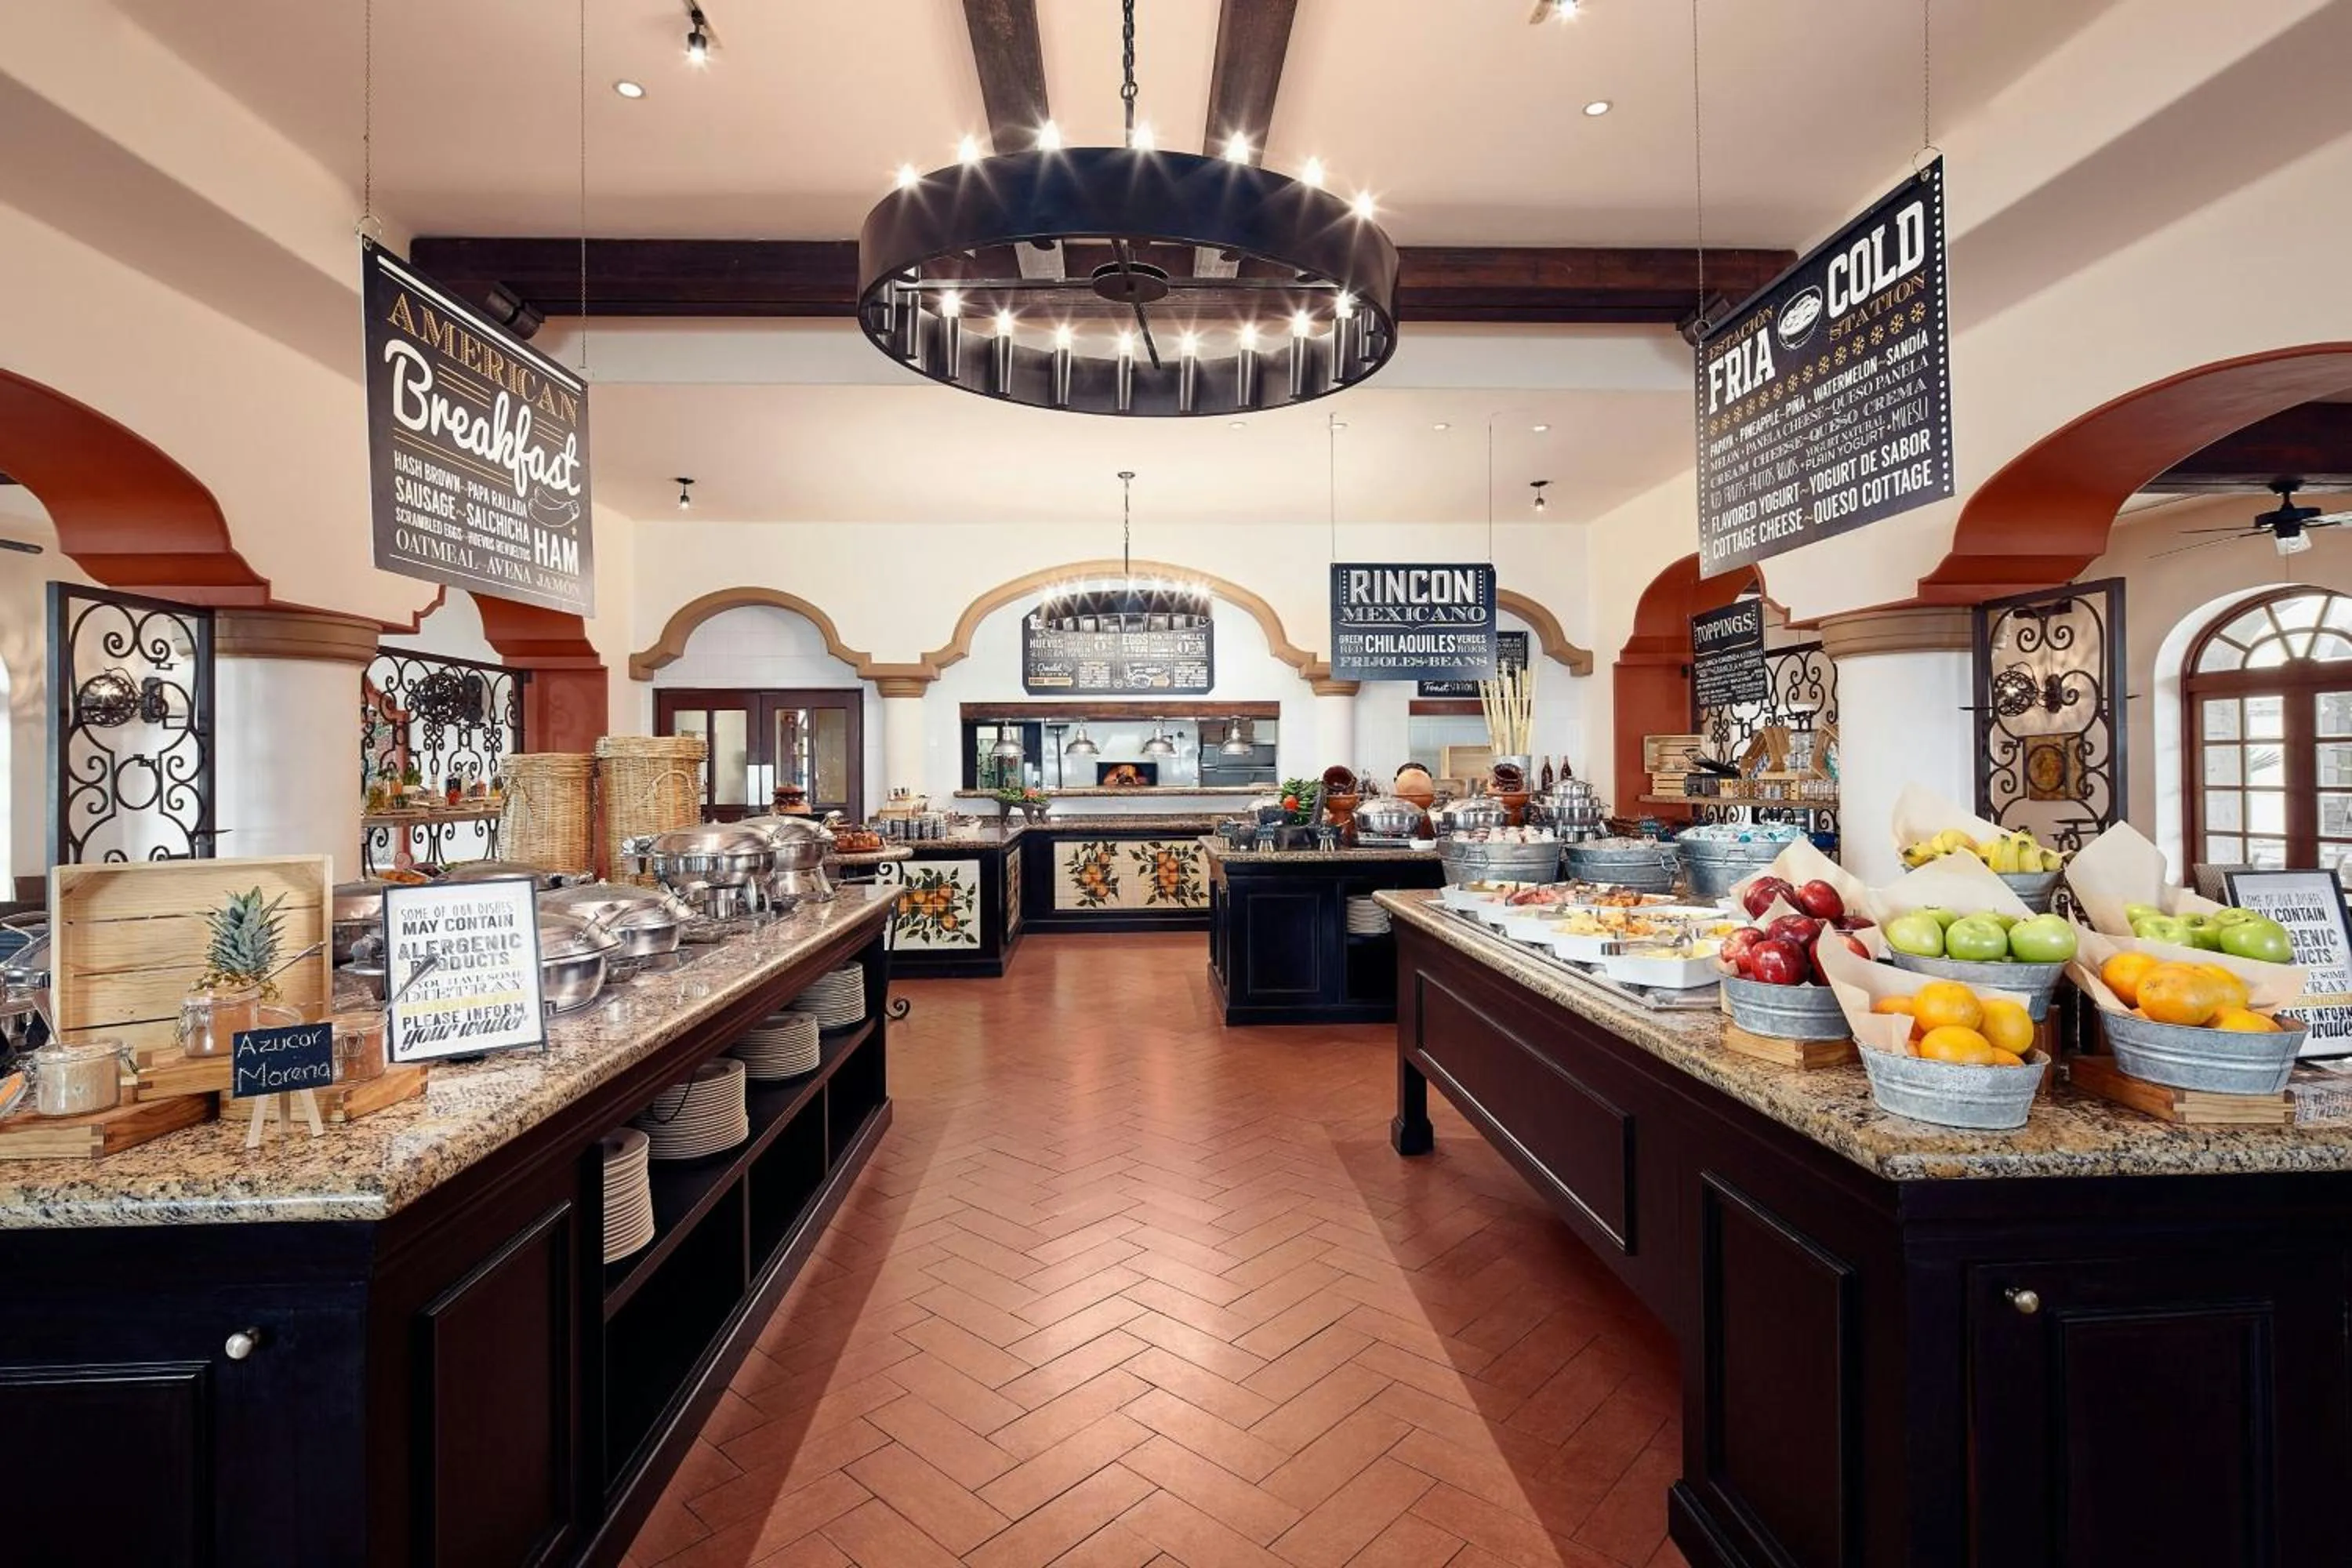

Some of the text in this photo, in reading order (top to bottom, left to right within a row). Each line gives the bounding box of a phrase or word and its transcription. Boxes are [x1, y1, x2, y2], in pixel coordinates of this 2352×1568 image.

[1828, 200, 1926, 319] COLD
[1829, 270, 1927, 342] STATION
[387, 292, 579, 426] AMERICAN
[1708, 326, 1776, 416] FRIA
[1711, 328, 1929, 459] PAPAYA PINEAPPLE PIÑA WATERMELON SANDÍA
[384, 339, 581, 498] Breakfast
[1711, 354, 1929, 472] MELON PANELA CHEESE QUESO PANELA
[1841, 415, 1886, 443] NATURAL
[1892, 396, 1929, 432] MUESLI
[1711, 377, 1928, 488] CREAM CHEESE QUESO CREMA
[1806, 426, 1885, 471] PLAIN YOGURT
[394, 450, 528, 518] HASH BROWN PAPA RALLADA
[1711, 428, 1932, 534] FLAVORED YOGURT YOGURT DE SABOR
[394, 476, 531, 545] SAUSAGE SALCHICHA
[395, 507, 443, 535] SCRAMBLED
[445, 523, 463, 542] EGGS
[1712, 459, 1934, 560] COTTAGE CHEESE QUESO COTTAGE
[395, 528, 532, 584] OATMEAL AVENA
[533, 528, 579, 576] HAM
[1349, 569, 1477, 604] RINCON
[1341, 606, 1486, 622] MEXICANO
[1696, 612, 1753, 644] TOPPINGS
[1338, 635, 1363, 644] GREEN
[1365, 633, 1456, 654] CHILAQUILES
[1456, 634, 1486, 644] VERDES
[1339, 655, 1487, 667] FRIJOLES BEANS
[401, 907, 428, 921] SOME
[434, 906, 445, 918] OF
[402, 913, 514, 935] MAY CONTAIN
[2274, 907, 2327, 923] CONTAIN
[397, 933, 522, 960] ALERGENIC
[2289, 927, 2339, 948] GENIC
[410, 951, 510, 976] PODUCTS
[2296, 948, 2334, 965] UCTS
[400, 1014, 529, 1052] your waiter
[402, 1011, 461, 1029] PLEASE
[467, 1002, 524, 1021] INFORM
[2281, 1008, 2310, 1023] EASE
[2312, 1019, 2352, 1040] waite
[238, 1062, 331, 1093] Morena
